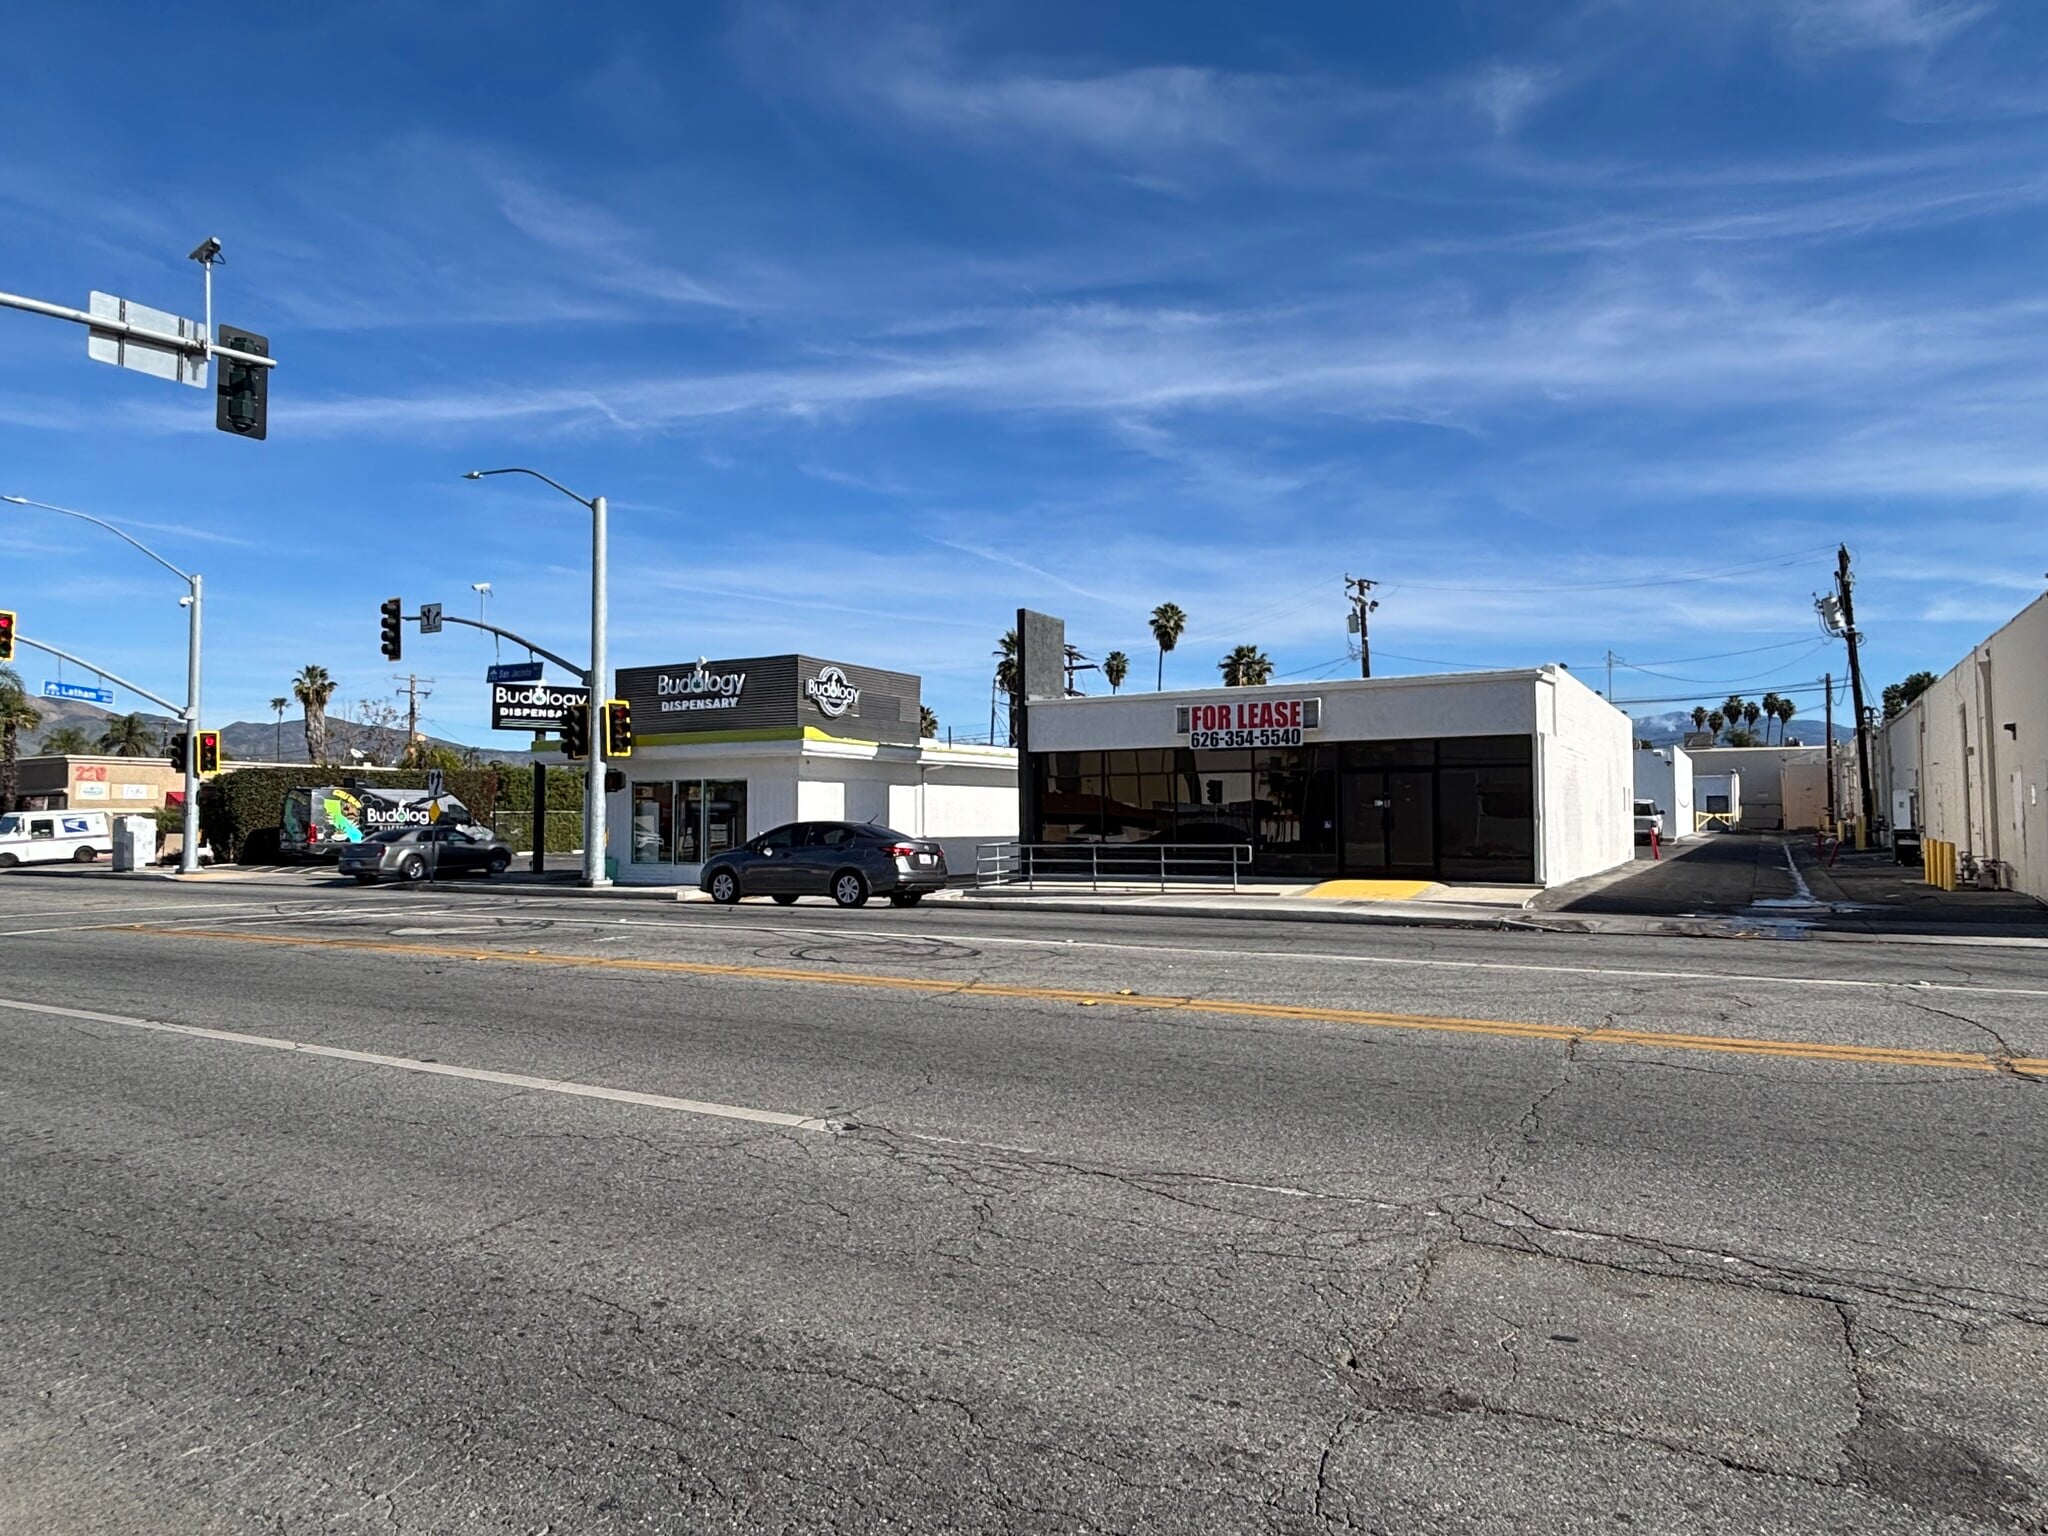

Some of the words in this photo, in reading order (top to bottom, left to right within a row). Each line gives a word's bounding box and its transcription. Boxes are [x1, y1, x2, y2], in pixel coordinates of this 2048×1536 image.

[61, 685, 97, 700] Latham
[658, 670, 746, 696] Budology
[808, 678, 860, 704] Budology
[661, 697, 739, 712] DISPENSARY
[1191, 705, 1231, 731] FOR
[1237, 701, 1301, 729] LEASE
[1191, 728, 1301, 748] 626-354-5540
[367, 807, 434, 825] Budolog
